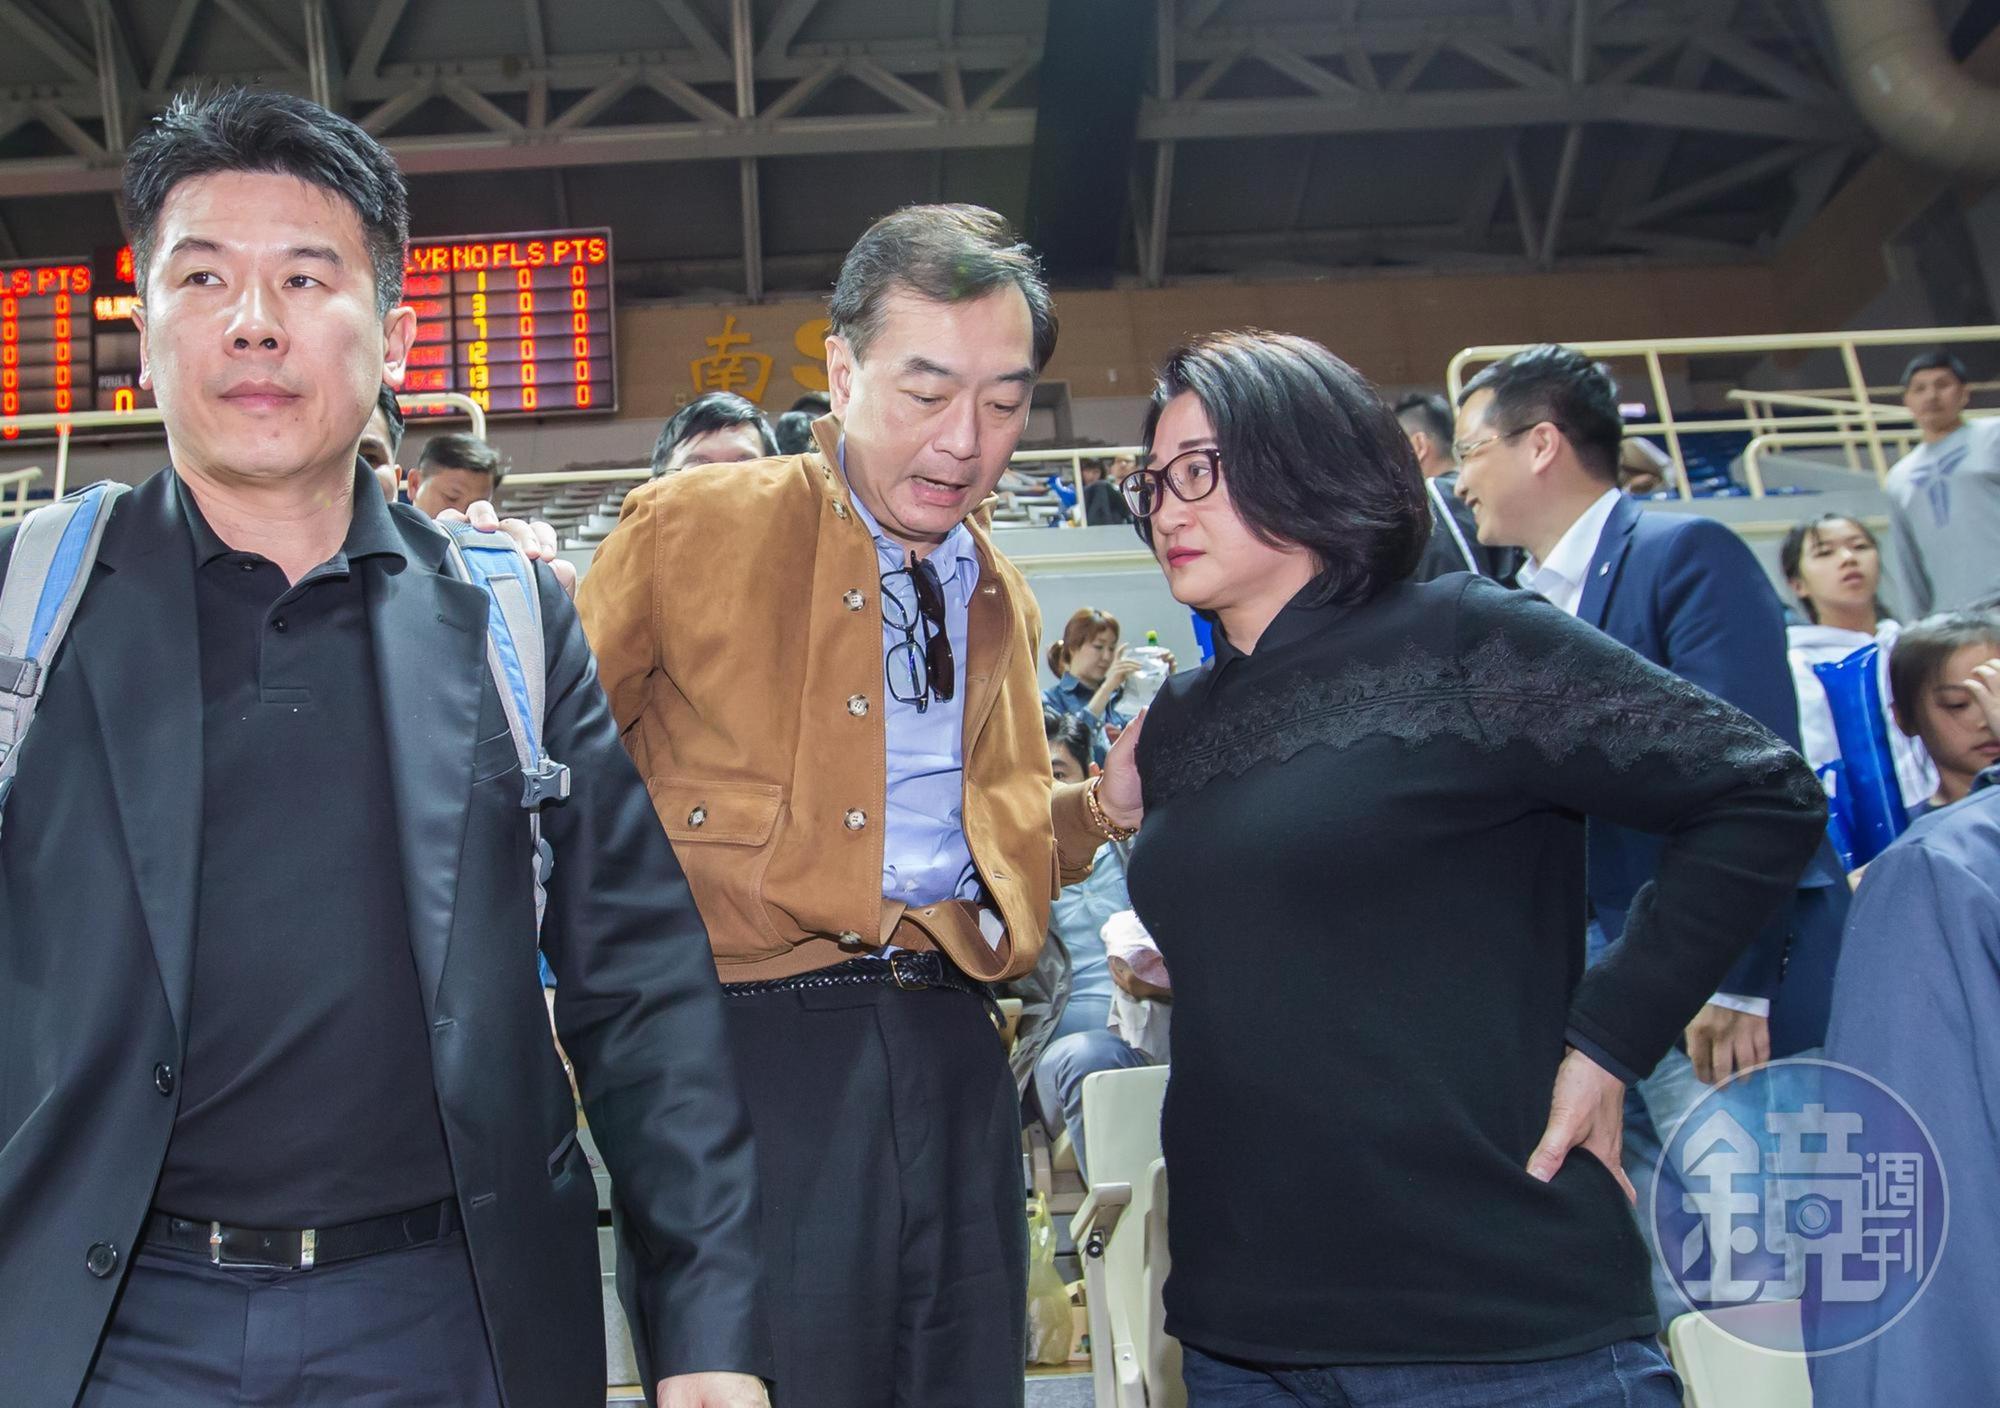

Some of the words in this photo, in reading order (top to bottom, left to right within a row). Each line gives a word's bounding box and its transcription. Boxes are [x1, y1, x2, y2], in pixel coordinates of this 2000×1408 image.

[405, 246, 450, 272] YR
[452, 244, 487, 271] NO
[492, 240, 546, 268] FLS
[552, 238, 606, 265] PTS
[36, 265, 91, 295] PTS
[518, 267, 532, 289] 0
[571, 265, 585, 287] 0
[2, 297, 17, 319] 0
[55, 294, 70, 315] 0
[472, 293, 486, 317] 3
[519, 292, 533, 313] 0
[572, 289, 587, 311] 0
[2, 321, 17, 342] 0
[55, 317, 70, 339] 0
[520, 316, 534, 337] 0
[574, 312, 588, 334] 0
[2, 344, 17, 366] 0
[55, 341, 70, 362] 0
[468, 340, 488, 365] 12
[521, 340, 535, 361] 0
[574, 336, 589, 358] 0
[690, 315, 774, 402] 南
[3, 367, 18, 389] 0
[55, 364, 70, 386] 0
[469, 365, 489, 390] 13
[521, 363, 536, 385] 0
[575, 360, 590, 383] 0
[3, 391, 18, 413] 0
[55, 388, 70, 410] 0
[522, 387, 537, 410] 0
[576, 384, 591, 407] 0
